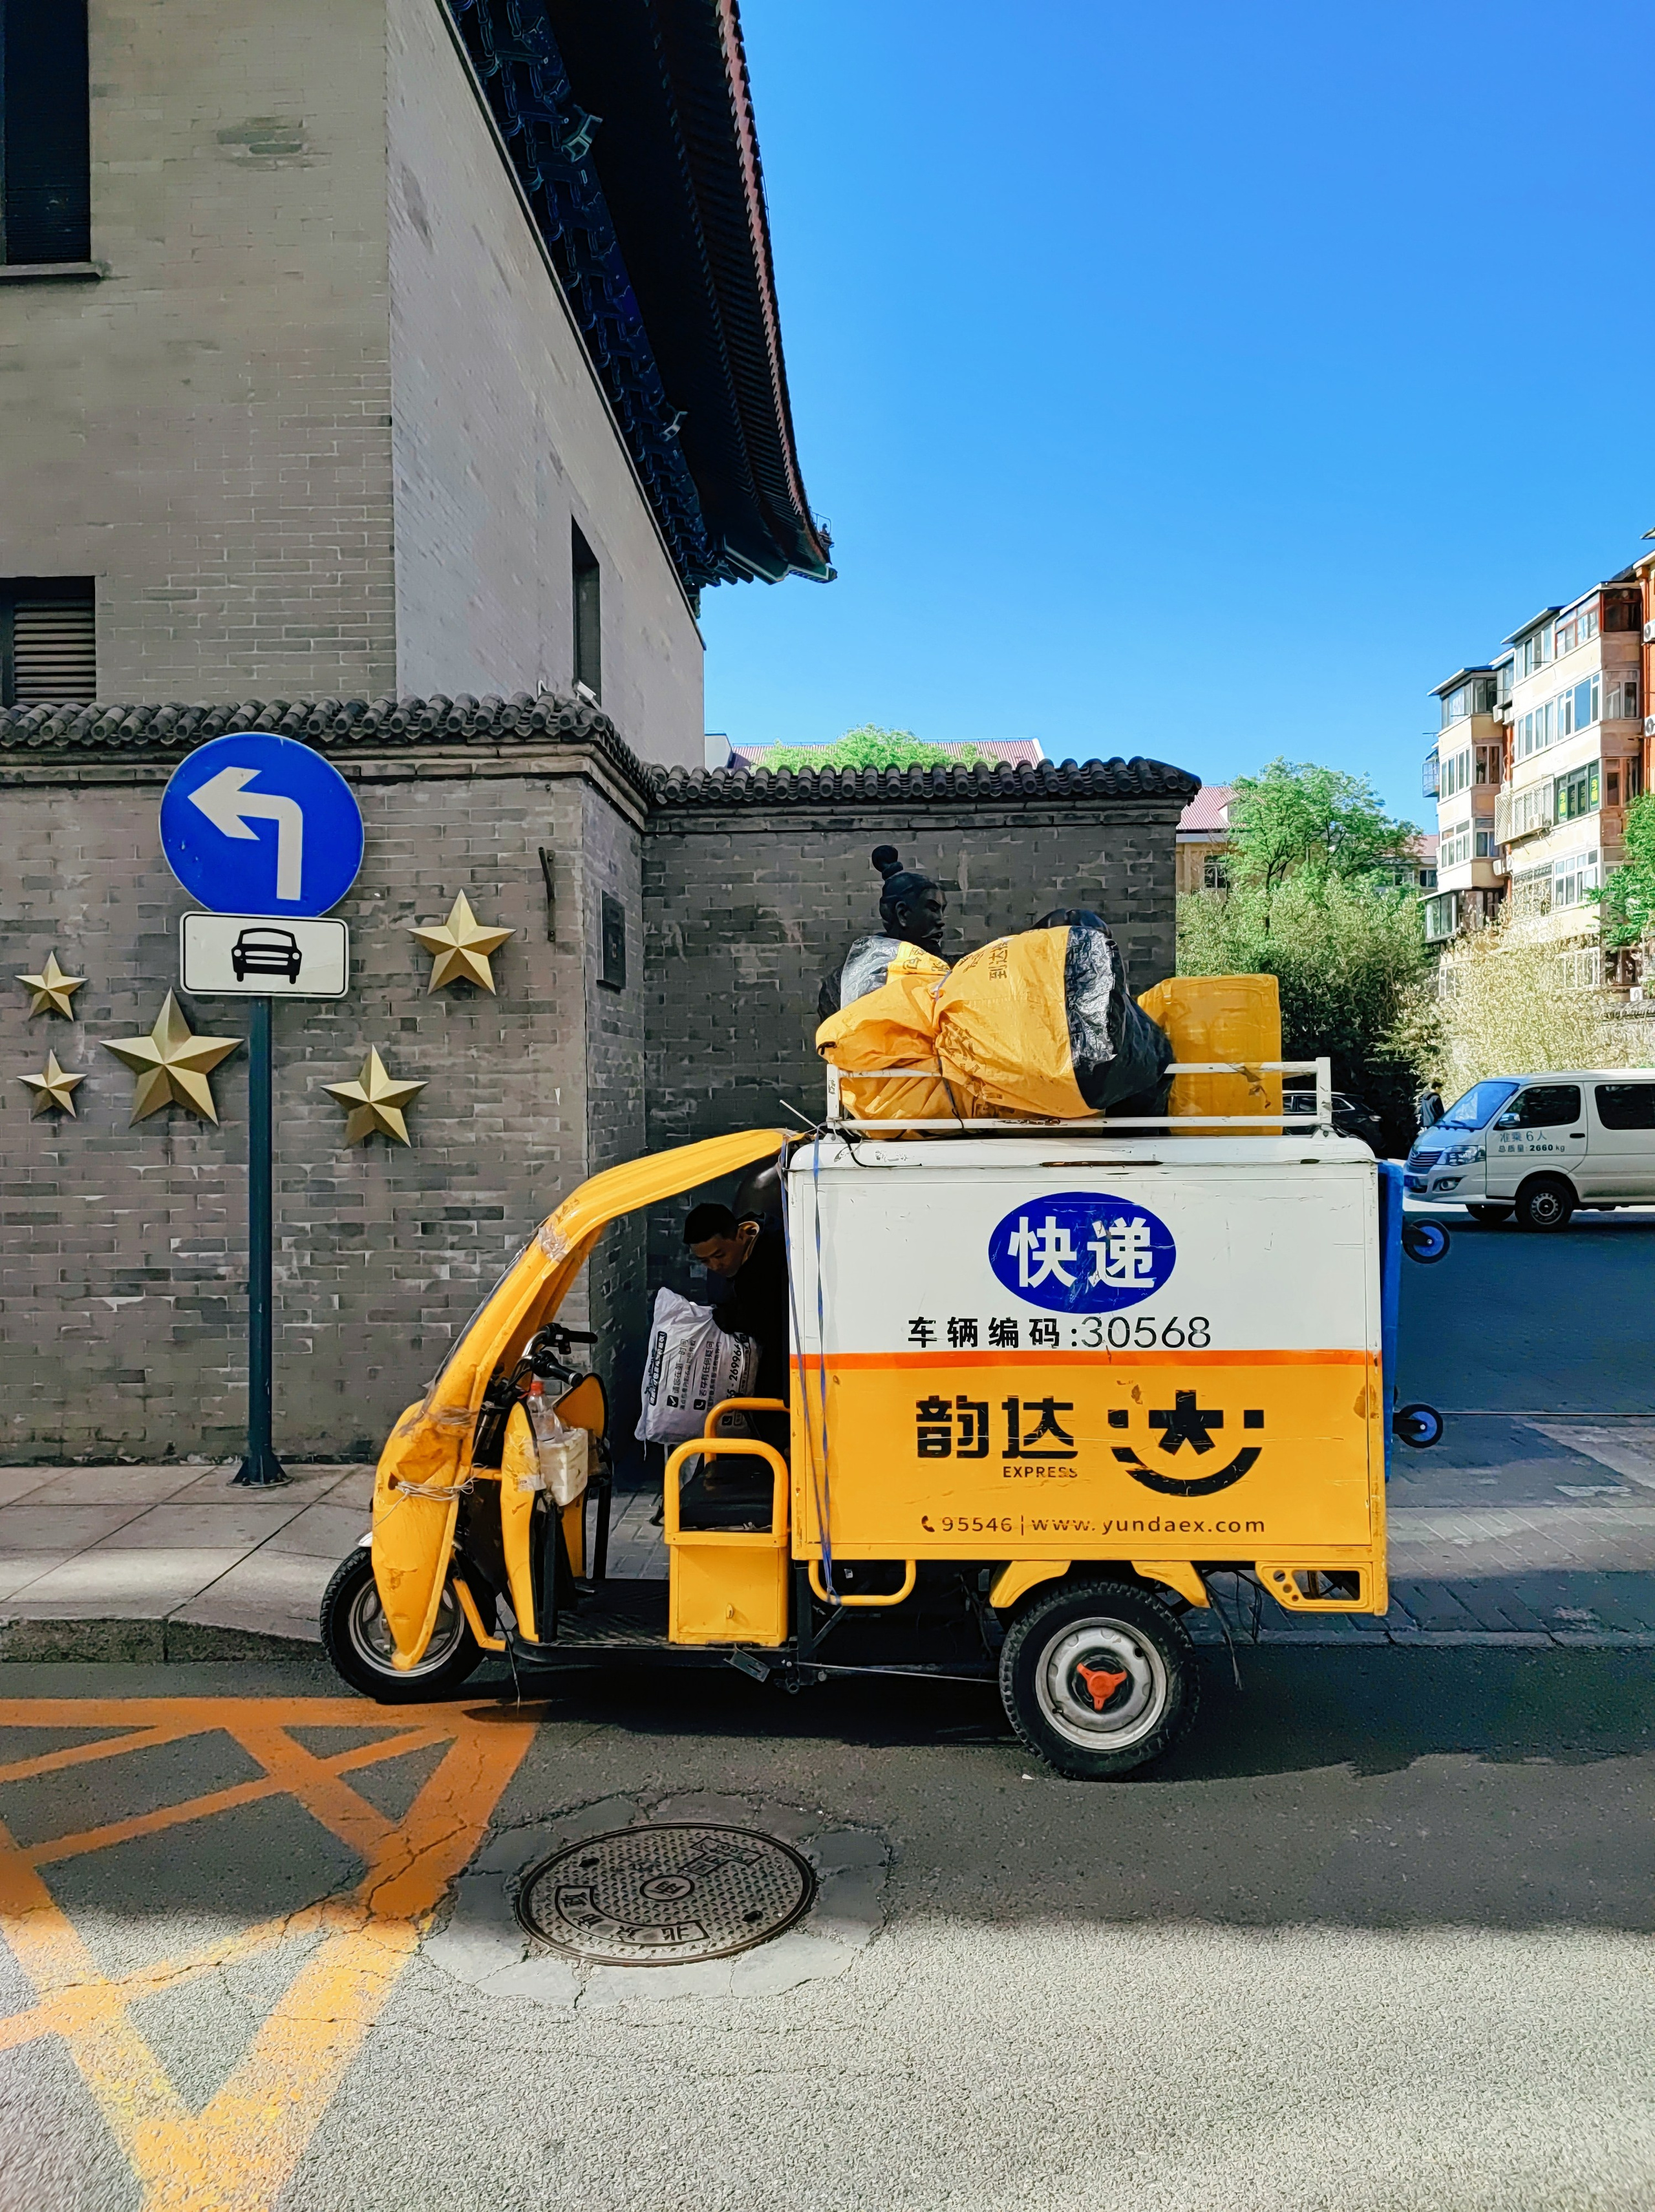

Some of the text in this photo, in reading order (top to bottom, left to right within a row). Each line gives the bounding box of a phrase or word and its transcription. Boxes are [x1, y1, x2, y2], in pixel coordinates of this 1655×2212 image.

[1499, 1130, 1548, 1143] 准乘6人
[1007, 1215, 1156, 1289] 快递
[915, 1395, 1078, 1460] 韵达
[1003, 1466, 1078, 1478] EXPRESS
[942, 1516, 1012, 1532] 95546
[560, 1890, 691, 1942] 北京市政
